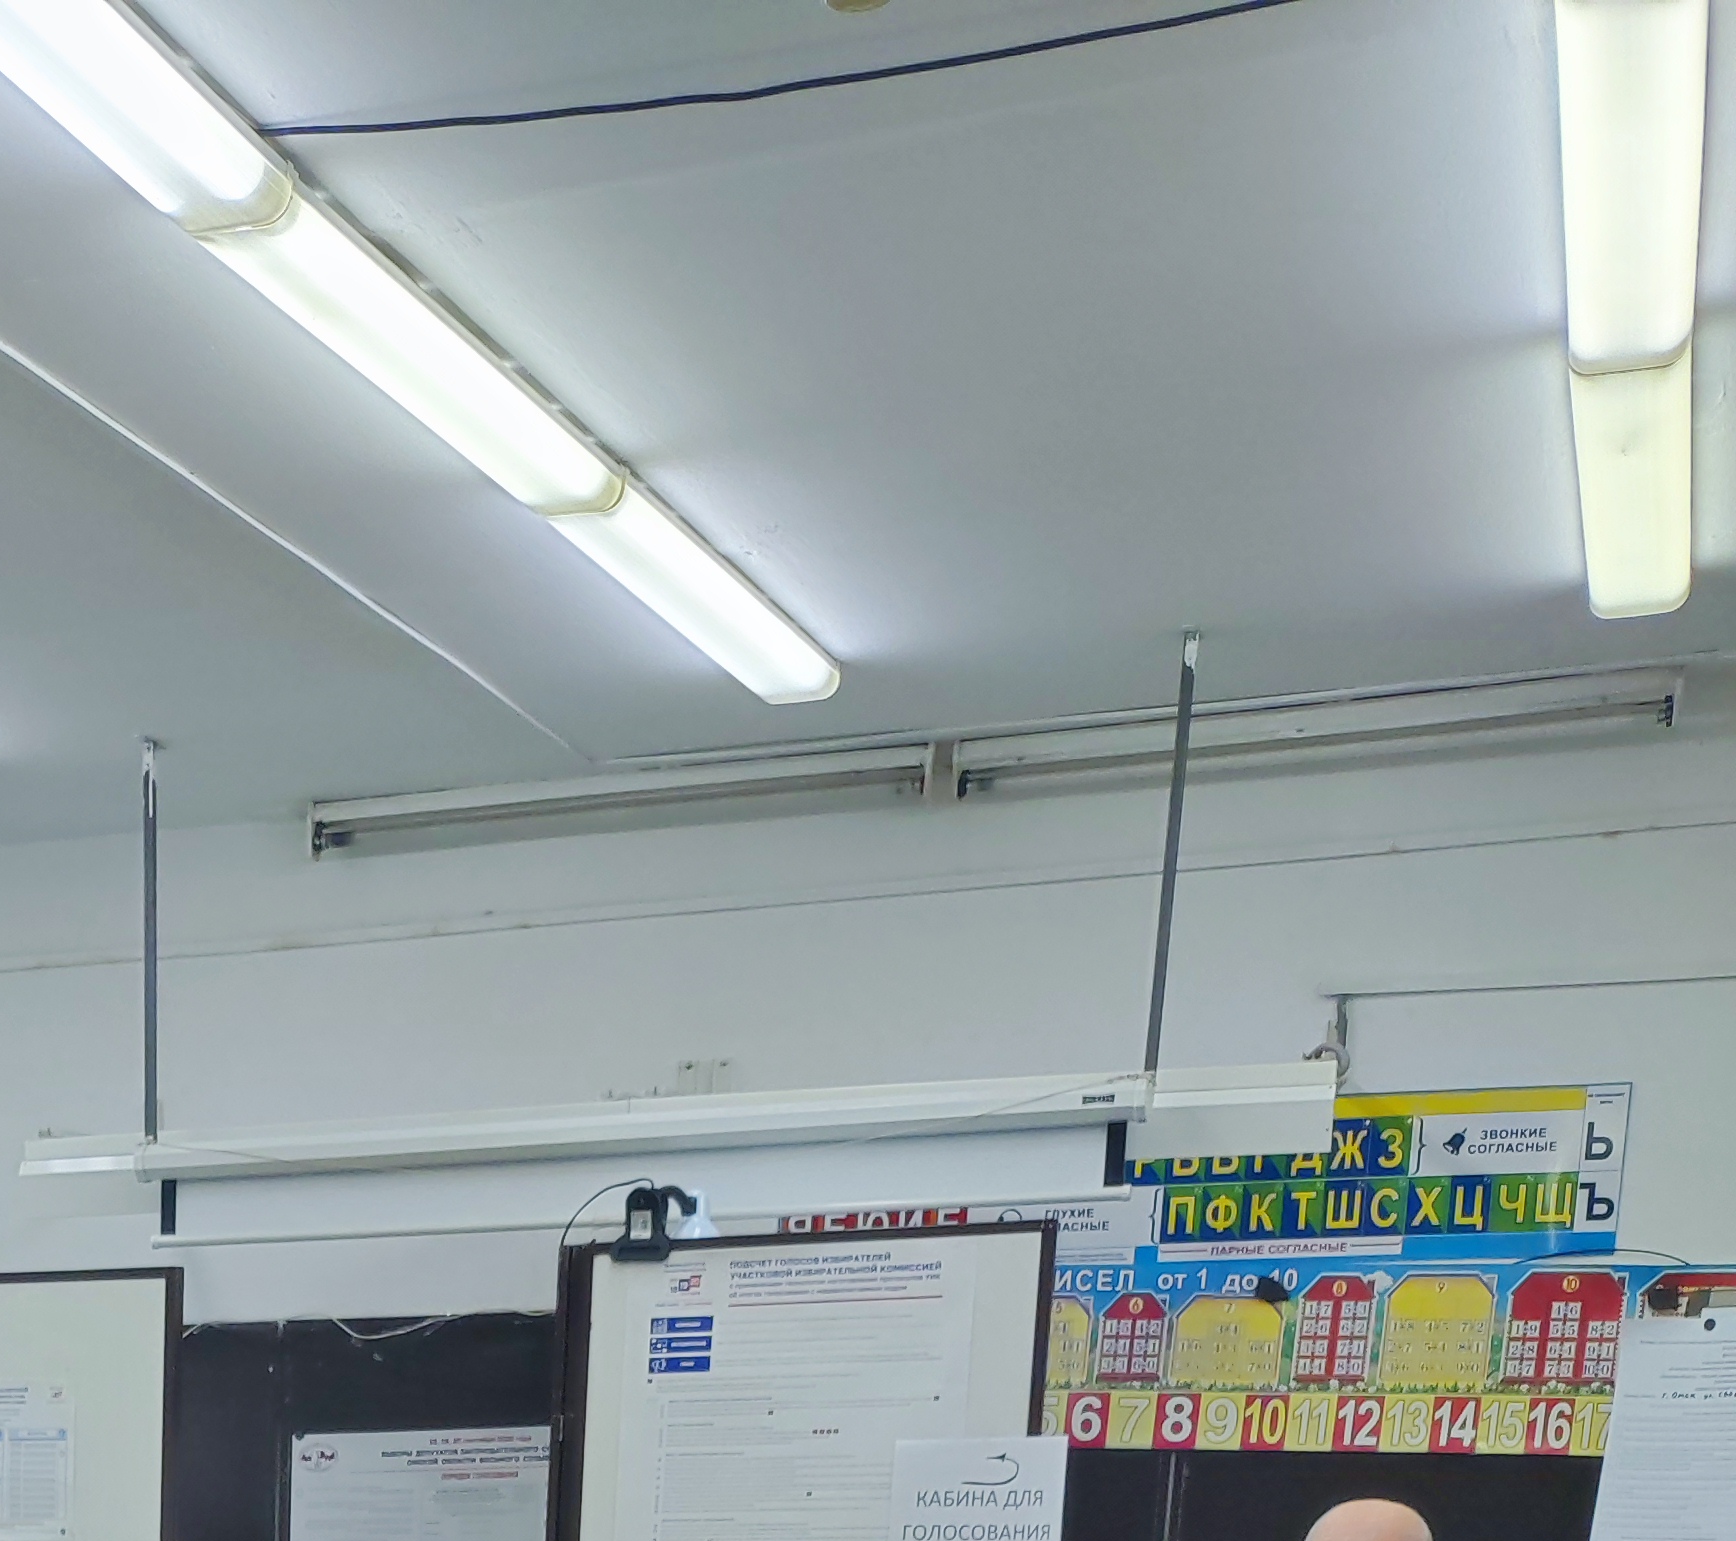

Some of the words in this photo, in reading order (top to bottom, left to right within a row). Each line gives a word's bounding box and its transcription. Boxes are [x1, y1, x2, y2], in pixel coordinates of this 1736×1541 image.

[1480, 1127, 1547, 1141] ЗВОНКИЕ
[1467, 1141, 1557, 1155] СОГЛАСНЫЕ
[1045, 1208, 1094, 1220] ГЛУХИЕ
[1058, 1220, 1110, 1232] АСНЫЕ
[1210, 1245, 1264, 1256] ПАРНЫЕ
[1268, 1242, 1348, 1254] СОГЛАСНЫЕ
[1054, 1269, 1135, 1292] ИСЕЛ
[1157, 1272, 1187, 1290] от
[1196, 1267, 1208, 1290] 1
[1221, 1274, 1259, 1294] до
[1269, 1267, 1298, 1291] 10
[1566, 1278, 1578, 1290] 10
[1071, 1396, 1102, 1442] 6
[1118, 1397, 1150, 1444] 7
[1160, 1396, 1194, 1443] 8
[1203, 1397, 1238, 1444] 9
[1244, 1398, 1286, 1445] 10
[1291, 1399, 1329, 1445] 11
[1337, 1399, 1381, 1447] 12
[1383, 1400, 1429, 1447] 13
[1434, 1400, 1477, 1447] 14
[1483, 1401, 1525, 1448] 15
[1527, 1401, 1572, 1449] 16
[1575, 1401, 1612, 1450] 17
[916, 1490, 998, 1508] КАБИНА
[1002, 1490, 1044, 1511] ДЛЯ
[902, 1524, 1051, 1541] ГОЛОСОВАНИЯ
